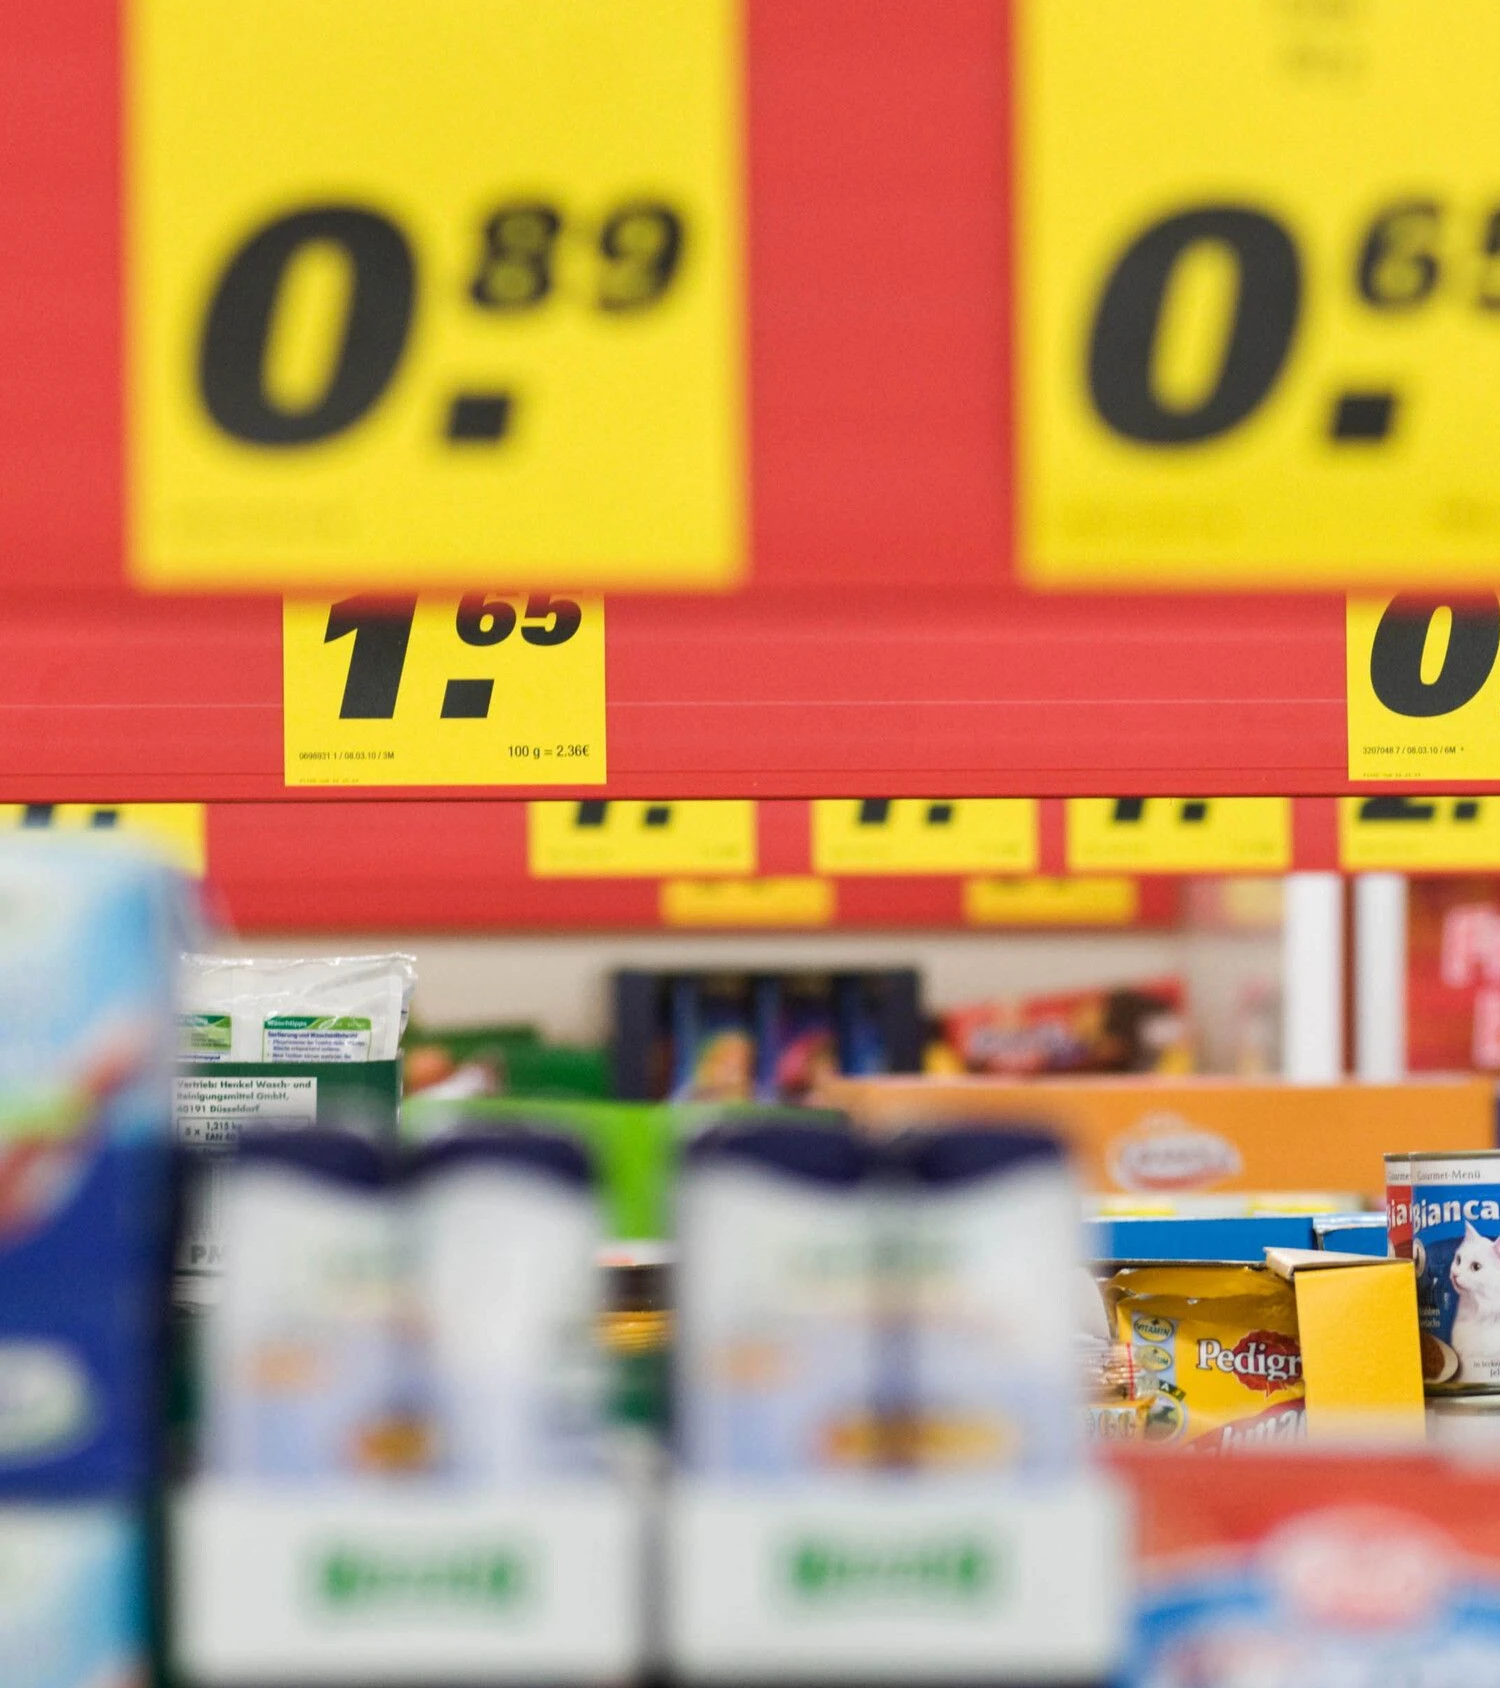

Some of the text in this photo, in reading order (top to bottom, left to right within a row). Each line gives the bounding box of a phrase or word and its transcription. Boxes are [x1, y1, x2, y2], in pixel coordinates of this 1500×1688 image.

[193, 200, 690, 450] 0.89
[509, 745, 529, 757] 100
[533, 748, 541, 759] g
[556, 745, 590, 757] 2.36€
[220, 1080, 253, 1089] Henkel
[256, 1080, 291, 1089] Wasch-
[293, 1080, 312, 1089] und
[210, 1103, 260, 1113] Düsseldorf
[1412, 1199, 1500, 1235] Bianca
[1136, 1323, 1170, 1337] VITAMIN
